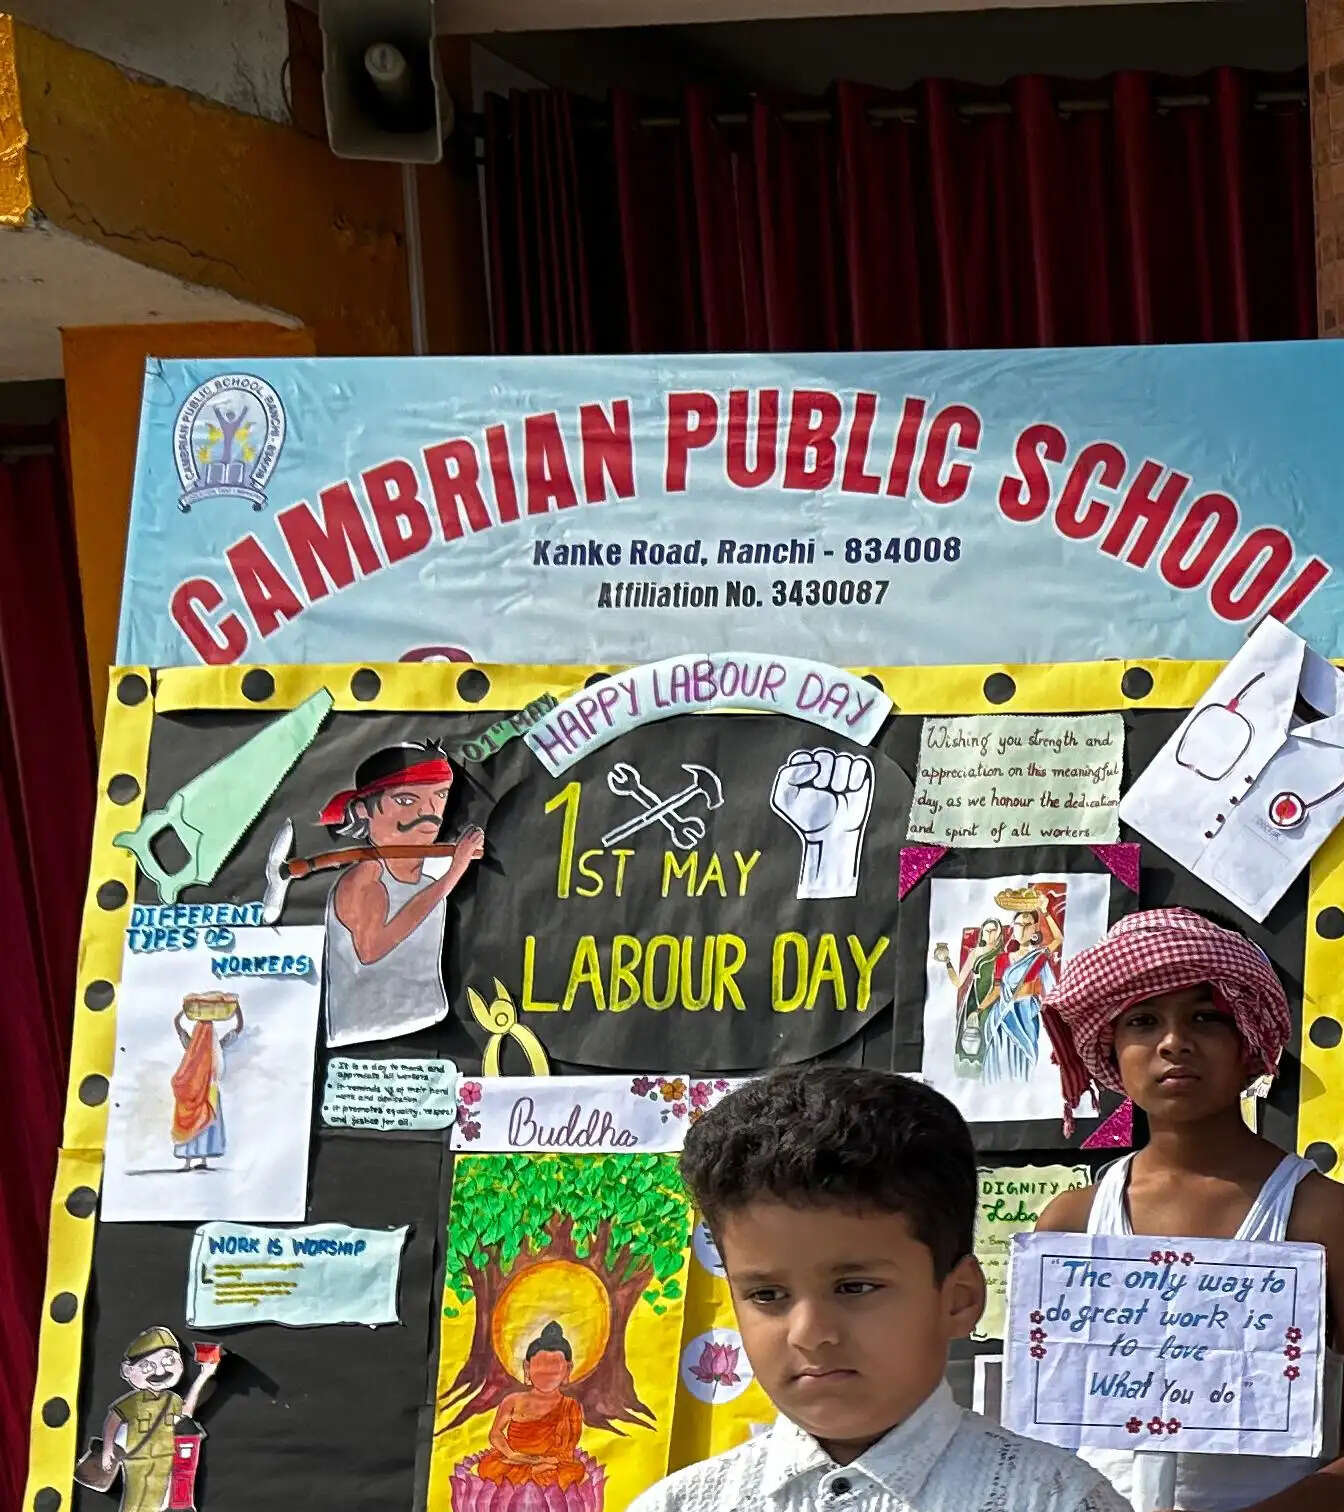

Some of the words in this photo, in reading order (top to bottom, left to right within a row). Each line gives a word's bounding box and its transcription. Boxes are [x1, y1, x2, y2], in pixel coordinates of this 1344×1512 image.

[171, 399, 636, 664] CAMBRIAN
[667, 389, 981, 504] PUBLIC
[533, 540, 621, 566] Kanke
[630, 540, 708, 568] Road,
[718, 539, 815, 566] Ranchi
[845, 536, 961, 564] 834008
[598, 581, 718, 609] Affiliation
[726, 581, 763, 607] No.
[772, 580, 890, 606] 3430087
[532, 682, 640, 766] HAPPY
[653, 660, 786, 708] LABOUR
[796, 673, 875, 726] DAY
[927, 726, 991, 755] Wishing
[998, 736, 1021, 754] you
[1028, 728, 1078, 753] strength
[1086, 731, 1113, 747] and
[921, 762, 1003, 784] appreciation
[1008, 766, 1023, 777] on
[1027, 762, 1047, 777] this
[1052, 764, 1118, 783] meaningful
[946, 797, 961, 807] as
[968, 797, 986, 807] we
[991, 788, 1034, 807] honour
[1040, 792, 1060, 808] the
[544, 781, 635, 898] 1ST
[661, 850, 761, 898] MAY
[910, 820, 935, 837] and
[946, 823, 979, 842] spirit
[991, 824, 1007, 842] of
[1012, 823, 1031, 837] all
[131, 904, 263, 927] DIFFERENT
[127, 928, 198, 950] TYPES
[205, 928, 231, 945] OF
[212, 956, 309, 974] WORKERS
[521, 933, 746, 1013] LABOUR
[772, 932, 890, 1013] DAY
[508, 1096, 638, 1148] Buddha
[982, 1181, 1060, 1196] DIGNITY
[982, 1200, 1038, 1222] Labo
[209, 1236, 260, 1255] WORK
[267, 1237, 283, 1256] IS
[291, 1238, 367, 1256] WORSHIP
[1124, 1263, 1186, 1301] only
[1198, 1273, 1254, 1303] way
[1261, 1270, 1287, 1294] to
[1045, 1294, 1072, 1322] do
[1069, 1298, 1149, 1332] great
[1159, 1304, 1230, 1329] work
[1242, 1309, 1274, 1331] is
[1107, 1333, 1139, 1358] to
[1155, 1335, 1209, 1362] love
[1089, 1370, 1154, 1400] What
[1159, 1378, 1194, 1406] You
